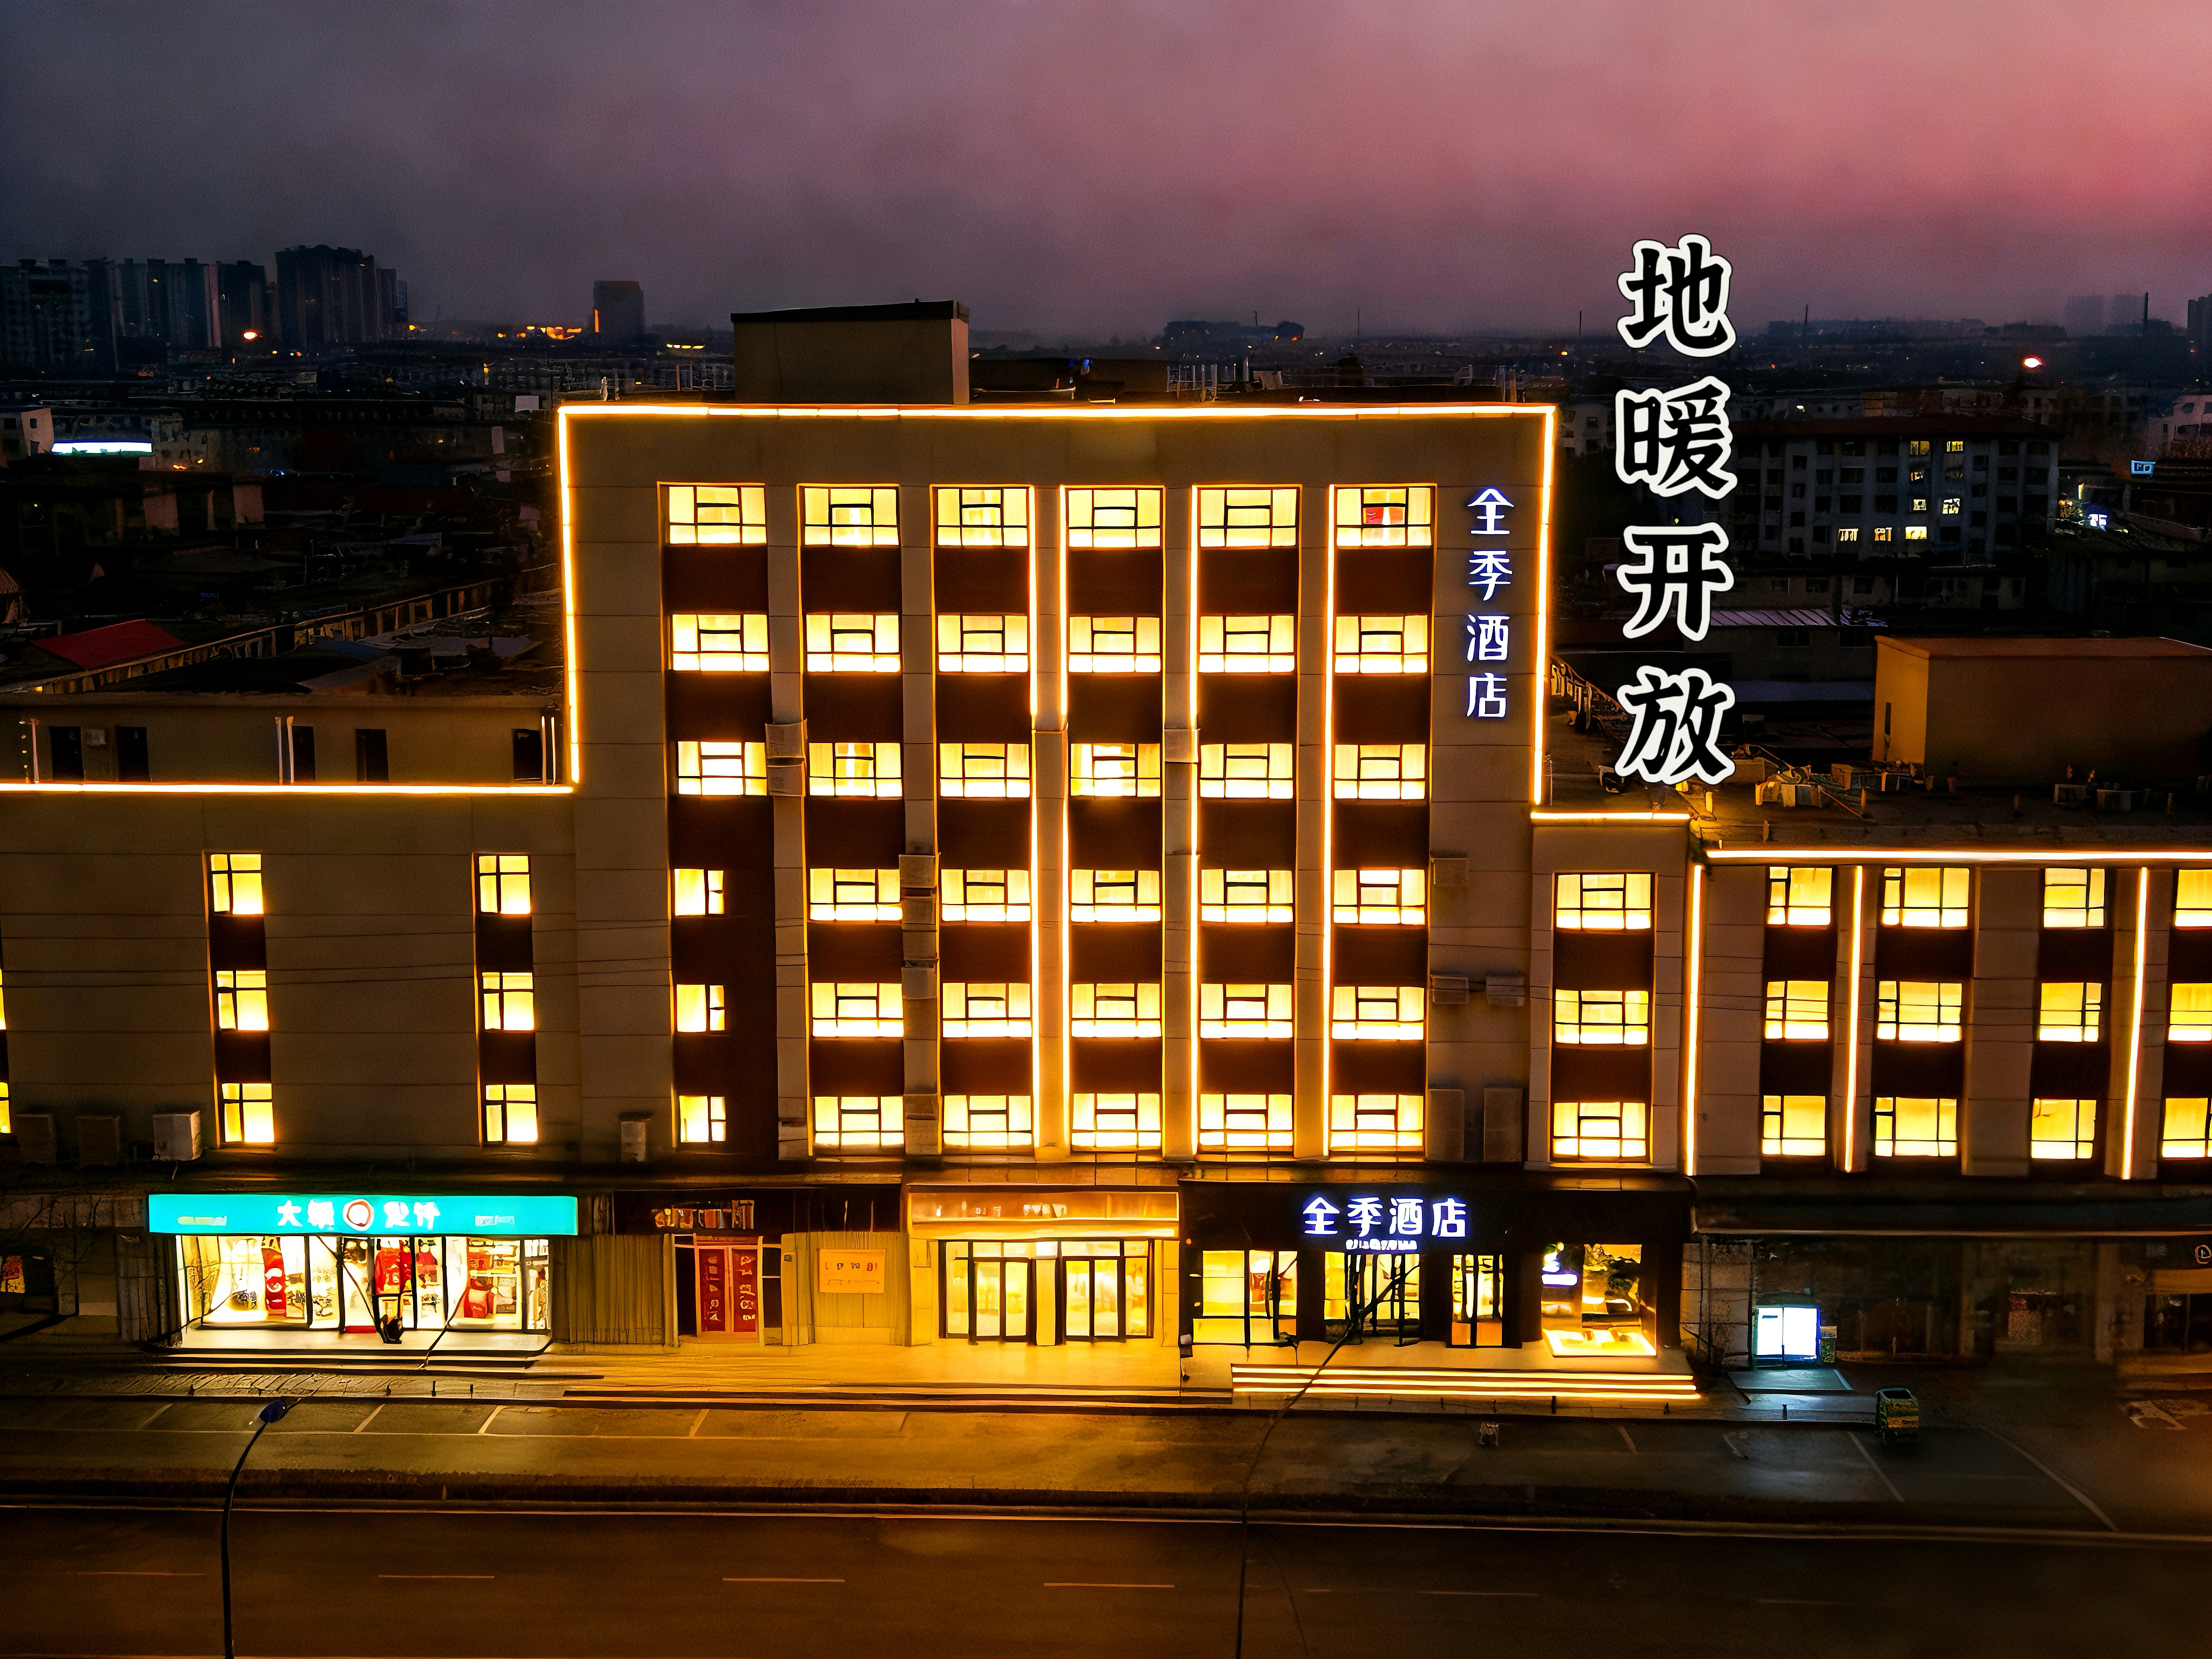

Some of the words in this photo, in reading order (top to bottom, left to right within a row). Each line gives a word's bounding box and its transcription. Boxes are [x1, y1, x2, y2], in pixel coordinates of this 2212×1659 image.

[1467, 488, 1514, 718] 全季酒店
[1303, 1196, 1467, 1237] 全季酒店
